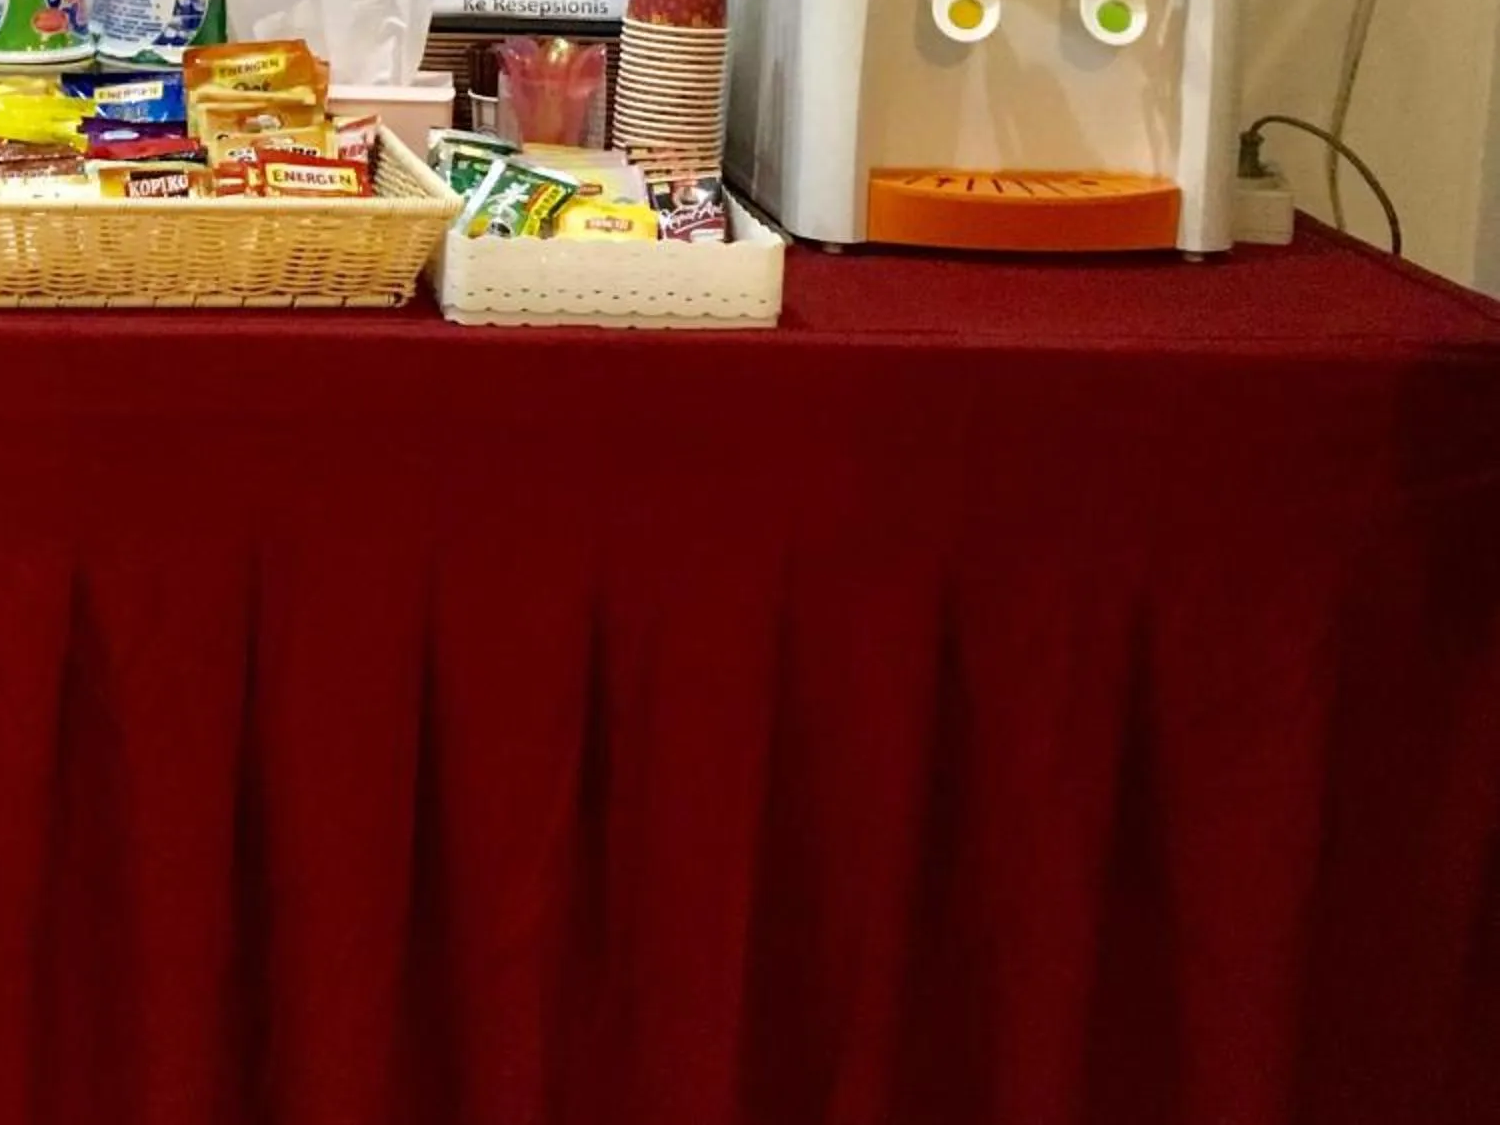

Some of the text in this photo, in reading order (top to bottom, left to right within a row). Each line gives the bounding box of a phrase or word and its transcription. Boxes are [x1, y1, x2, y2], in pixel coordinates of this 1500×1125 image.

[218, 57, 280, 74] ENERGEN
[128, 174, 188, 196] KOPIKO
[273, 169, 351, 185] ENERGEN
